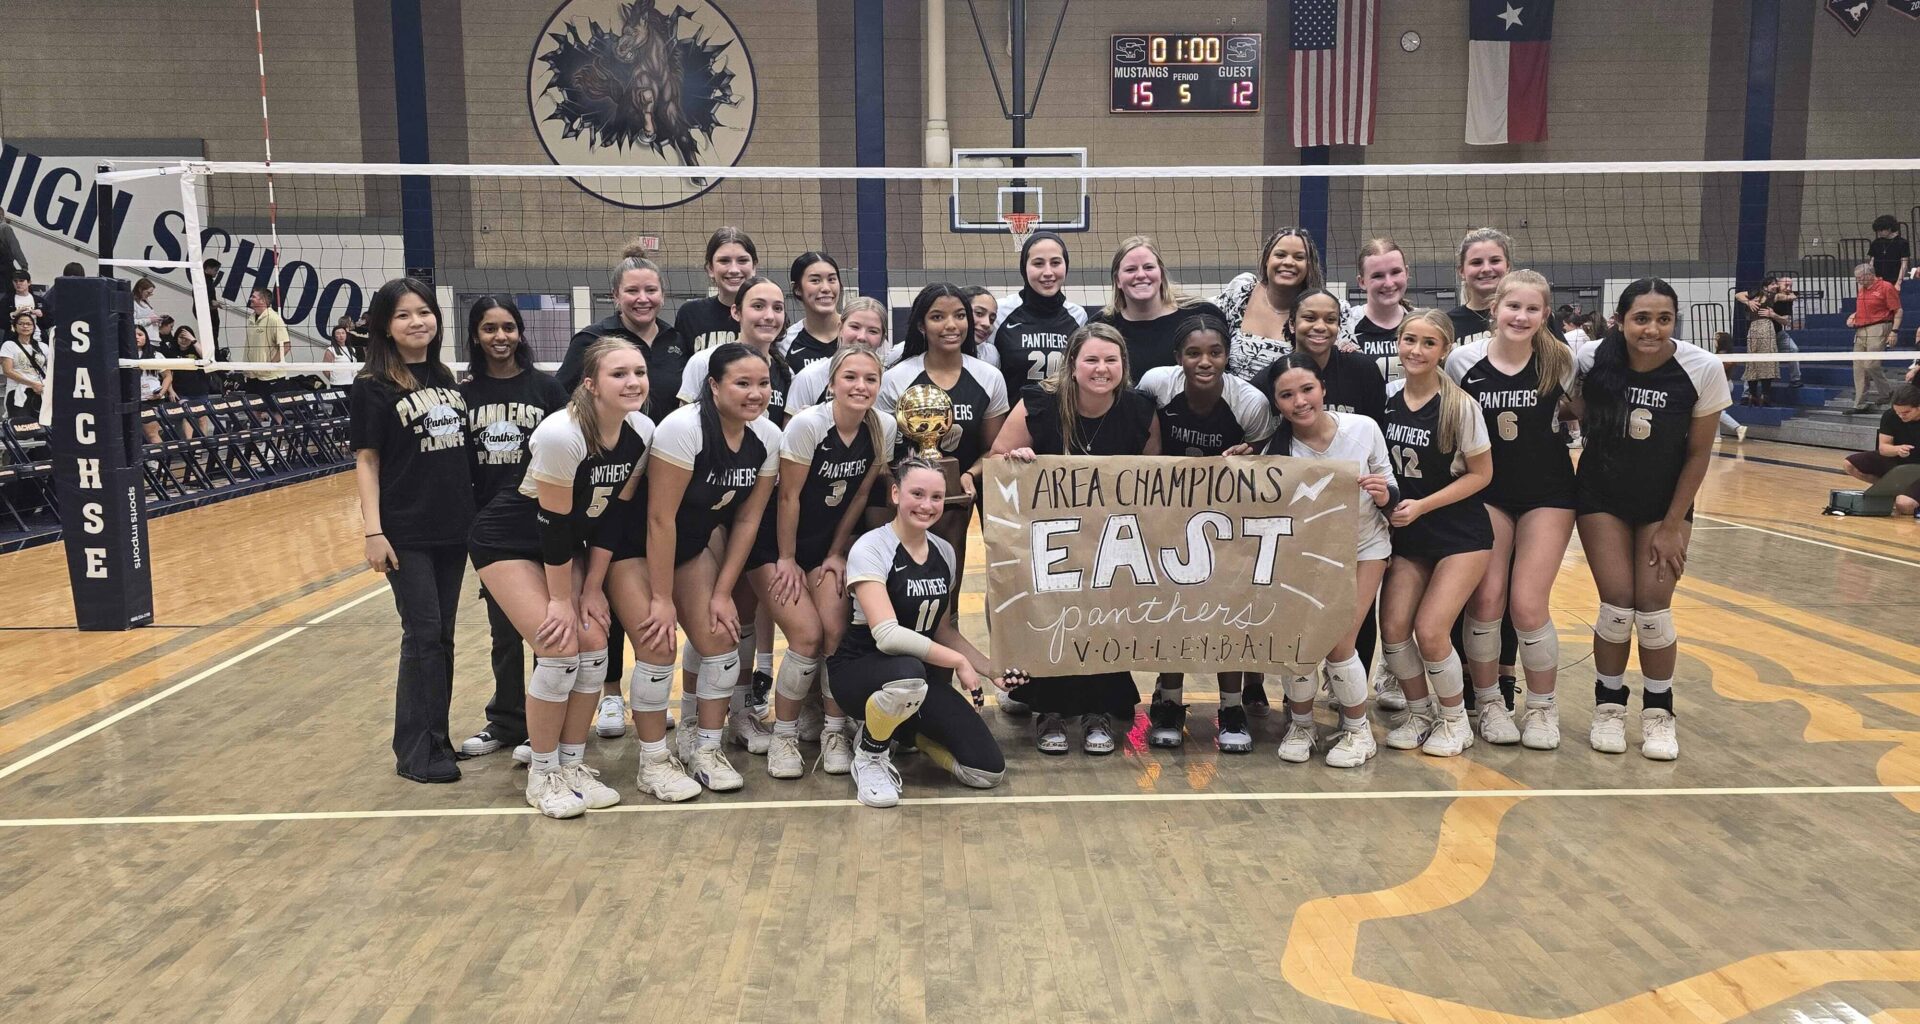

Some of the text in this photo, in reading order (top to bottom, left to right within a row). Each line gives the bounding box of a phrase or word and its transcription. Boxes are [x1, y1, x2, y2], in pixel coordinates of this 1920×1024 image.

[1152, 37, 1220, 63] 01:00
[1114, 67, 1169, 79] MUSTANGS
[1173, 73, 1199, 81] PERIOD
[1218, 66, 1254, 78] GUEST
[1132, 81, 1154, 106] 15
[1231, 81, 1254, 106] 12
[144, 210, 377, 341] SCHOO
[1022, 332, 1068, 349] PANTHERS
[1364, 340, 1399, 355] PANTH
[1479, 389, 1538, 409] PANTHERS
[480, 431, 524, 444] Panthers
[1171, 425, 1223, 447] PANTHERS
[1386, 422, 1431, 447] PANTHERS
[1497, 410, 1518, 441] 6
[71, 320, 108, 579] SACHSE
[1391, 444, 1423, 479] 12
[818, 458, 867, 479] PANTHERS
[824, 479, 848, 507] 3
[1031, 465, 1284, 510] AREA CHAMPIONS
[586, 486, 614, 518] 5
[128, 486, 142, 569] sports imports
[1030, 510, 1294, 594] EAST
[906, 578, 948, 597] PANTHERS
[915, 599, 940, 632] 11
[1027, 592, 1277, 664] panthers
